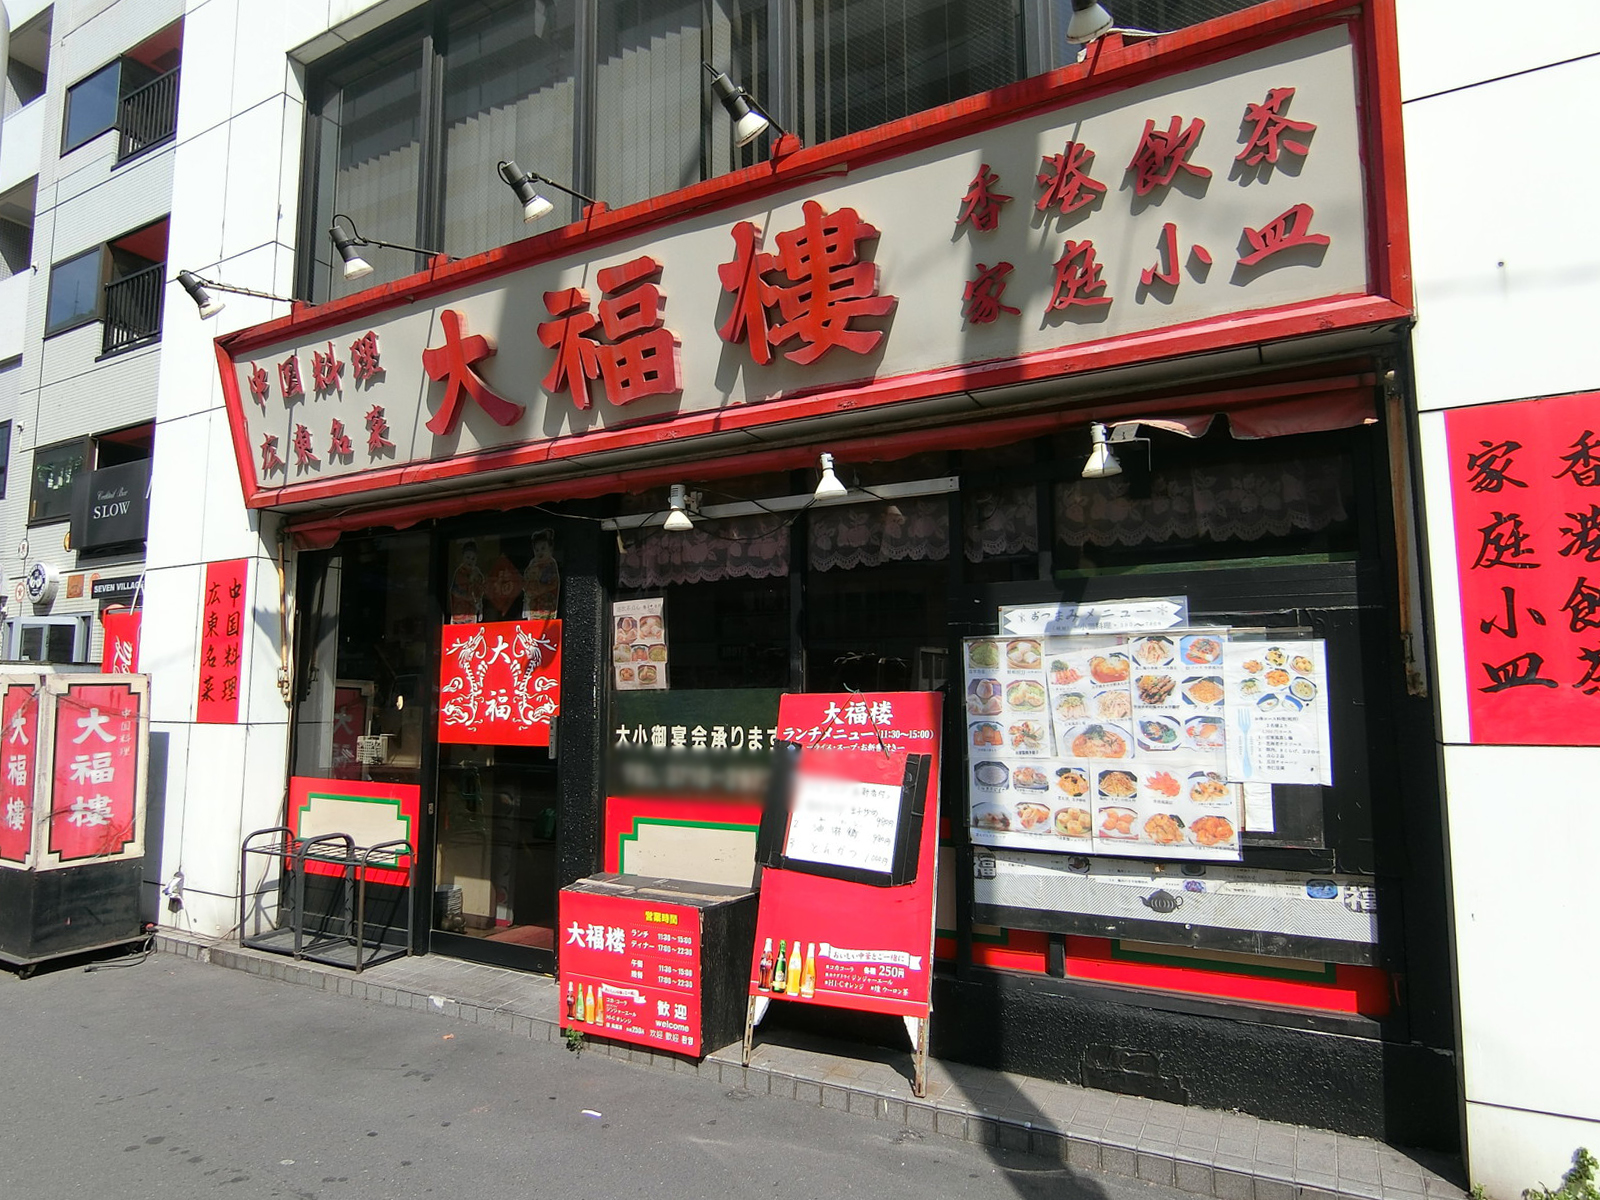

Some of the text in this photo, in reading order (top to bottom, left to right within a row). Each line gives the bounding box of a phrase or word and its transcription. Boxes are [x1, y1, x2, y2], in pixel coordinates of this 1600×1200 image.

[956, 87, 1317, 232] 香港飲茶
[964, 203, 1330, 324] 家庭小皿
[423, 198, 897, 436] 大福樓
[93, 500, 131, 519] SLOW
[94, 583, 115, 593] SEVEN
[1467, 440, 1559, 694] 家庭小皿
[200, 581, 221, 702] 広東名菜
[222, 578, 241, 702] 中国料理
[485, 635, 511, 722] 大福
[120, 708, 132, 757] 中国料理
[821, 700, 894, 726] 大福楼
[567, 921, 626, 954] 大福楼
[631, 929, 649, 938] ランチ
[879, 965, 905, 979] 250円
[655, 1019, 690, 1033] welcome
